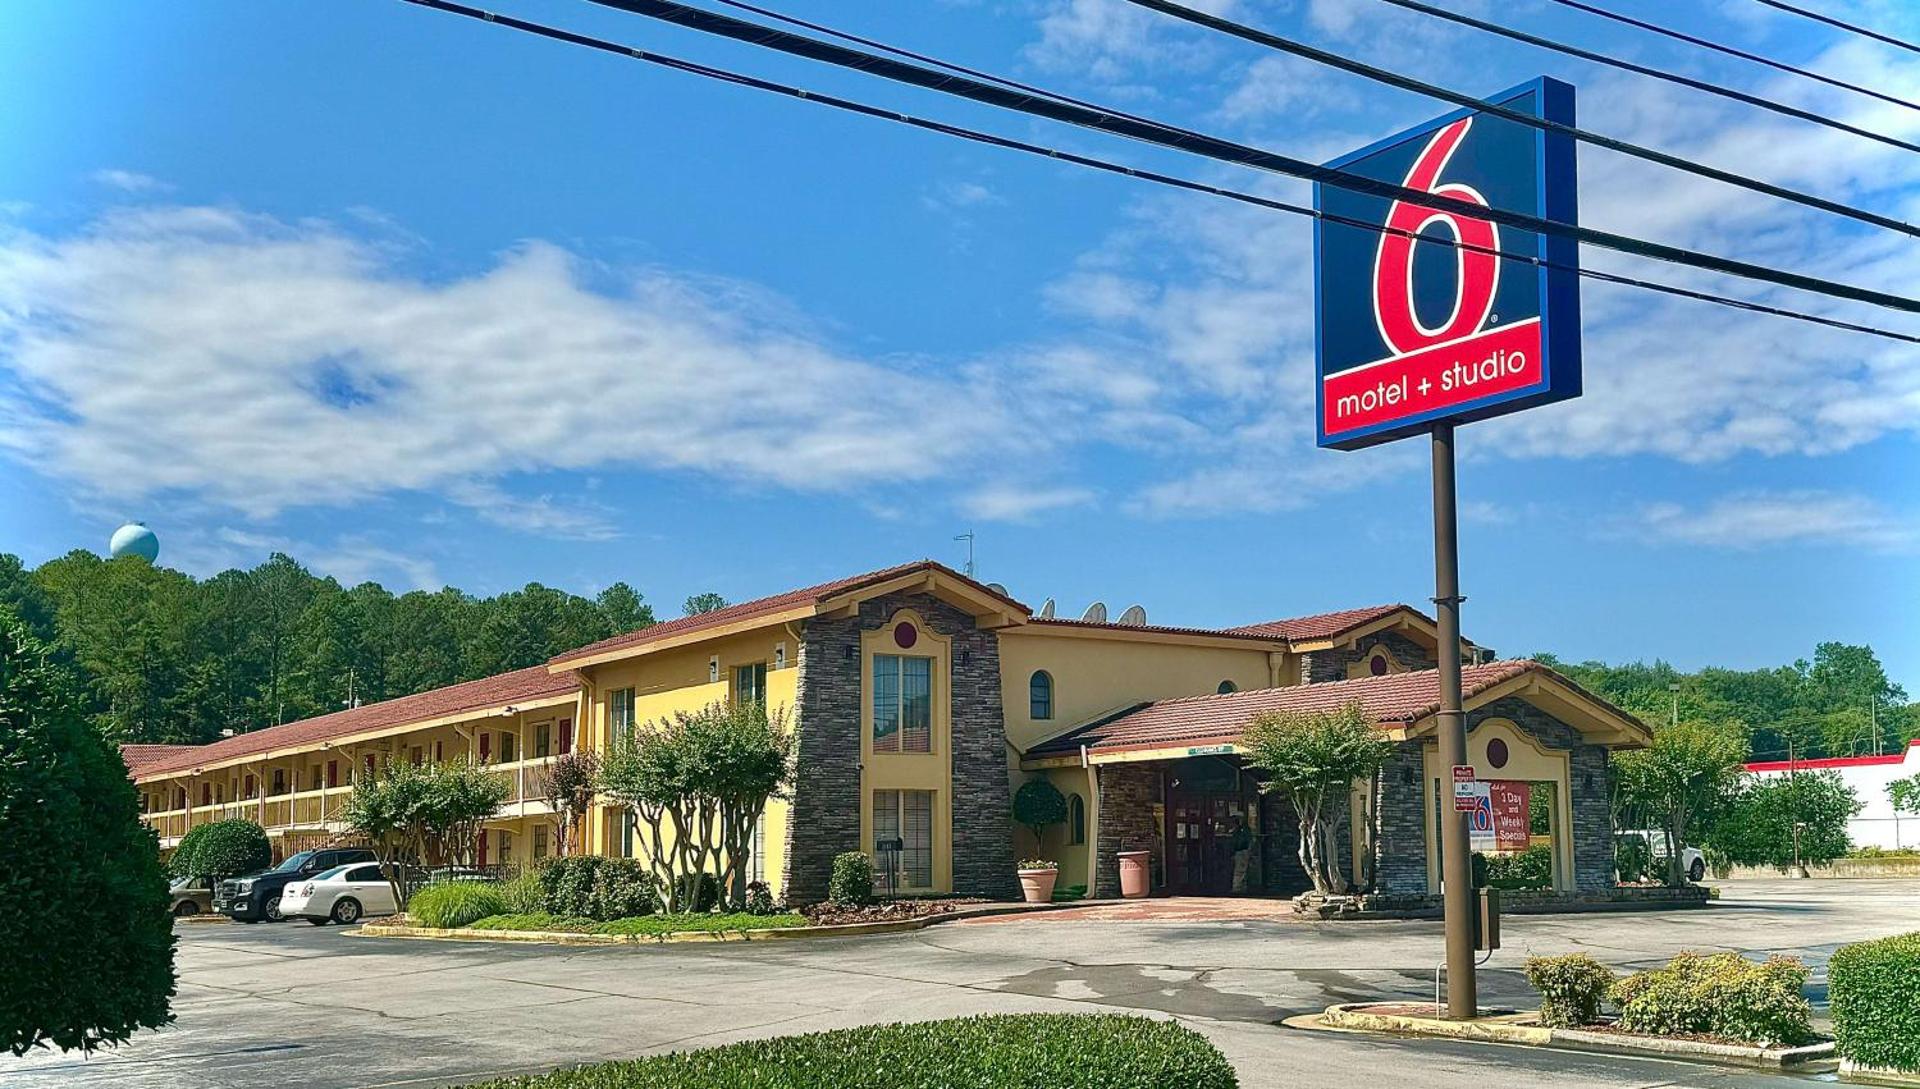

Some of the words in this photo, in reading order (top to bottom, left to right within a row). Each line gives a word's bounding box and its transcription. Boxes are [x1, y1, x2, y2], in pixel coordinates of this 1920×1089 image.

[1373, 116, 1501, 357] 6
[1337, 375, 1408, 418] motel
[1417, 377, 1432, 396] +
[1441, 349, 1526, 391] studio
[1507, 792, 1522, 805] Day
[1473, 796, 1492, 831] 6
[1500, 815, 1524, 829] Weekly
[1499, 830, 1527, 843] Specials
